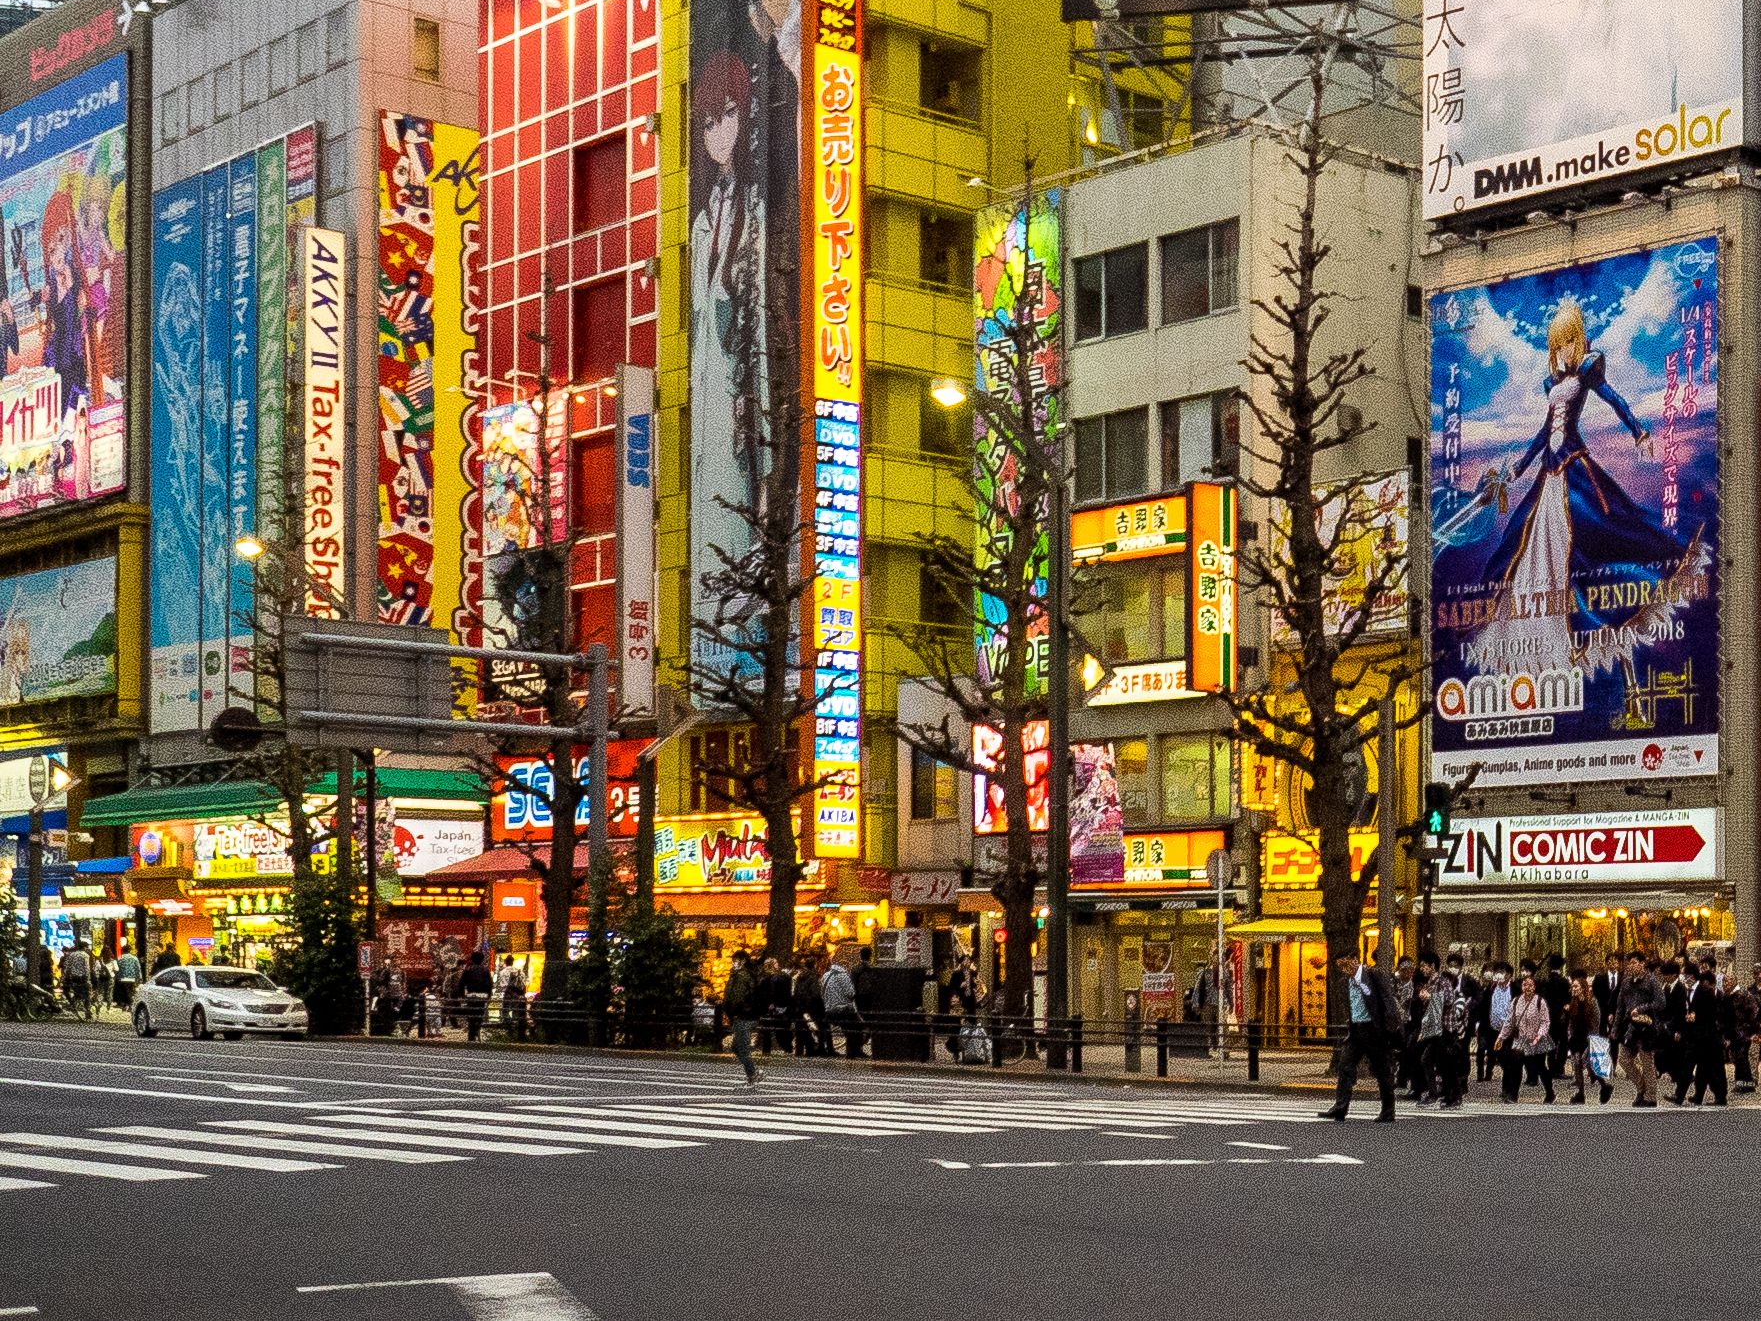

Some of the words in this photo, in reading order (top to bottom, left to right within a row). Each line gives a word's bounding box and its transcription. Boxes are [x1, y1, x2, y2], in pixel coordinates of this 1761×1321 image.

[1635, 104, 1733, 159] solar
[311, 235, 339, 347] AKKY
[311, 380, 340, 529] Tax-free
[1116, 504, 1167, 536] 吉野家
[1198, 542, 1219, 634] 吉野家
[821, 607, 853, 626] 買取
[1649, 622, 1686, 643] 2018
[1440, 669, 1581, 716] amiami
[1524, 756, 1555, 772] Anime
[1557, 756, 1586, 774] goods
[1588, 754, 1608, 767] and
[1611, 754, 1637, 767] more
[819, 810, 856, 825] AKIBA
[1443, 820, 1503, 882] ZIN
[1513, 830, 1608, 865] COMIC
[1613, 828, 1654, 863] ZIN
[1509, 867, 1589, 882] Akihabara
